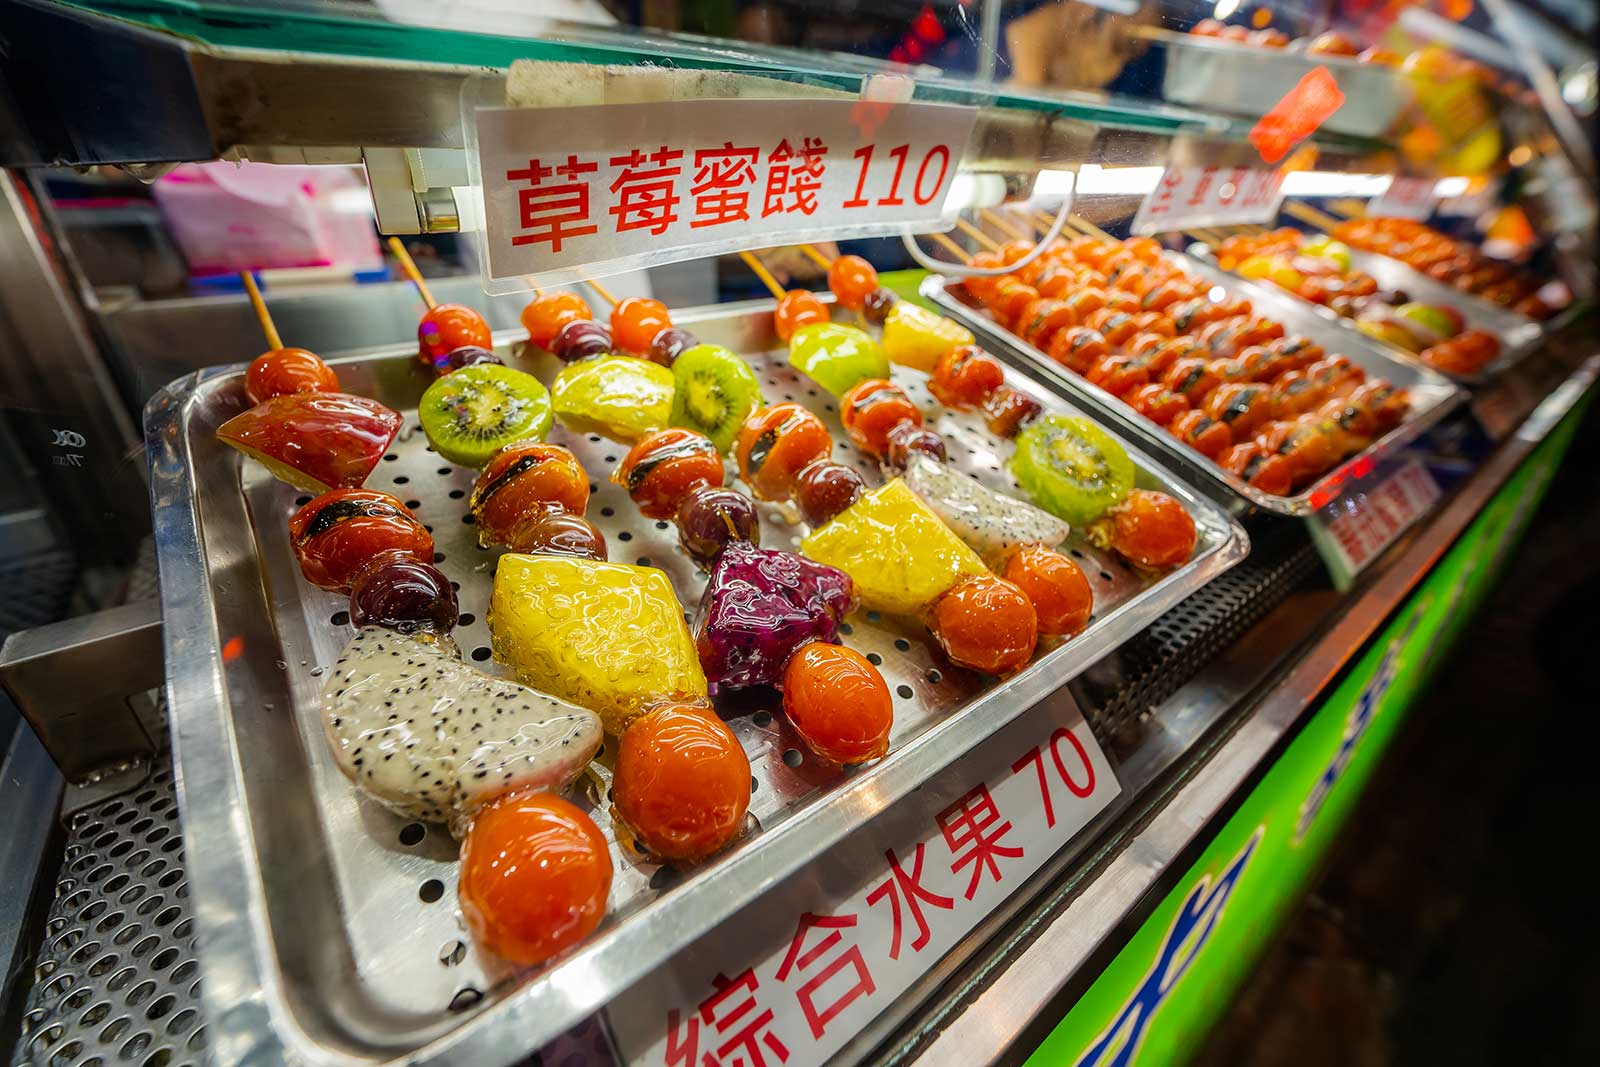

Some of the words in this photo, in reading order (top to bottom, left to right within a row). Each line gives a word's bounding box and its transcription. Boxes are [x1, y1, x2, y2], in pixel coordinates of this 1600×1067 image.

[507, 138, 828, 253] 草莓蜜餞
[842, 143, 951, 208] 110
[1010, 727, 1097, 829] 70
